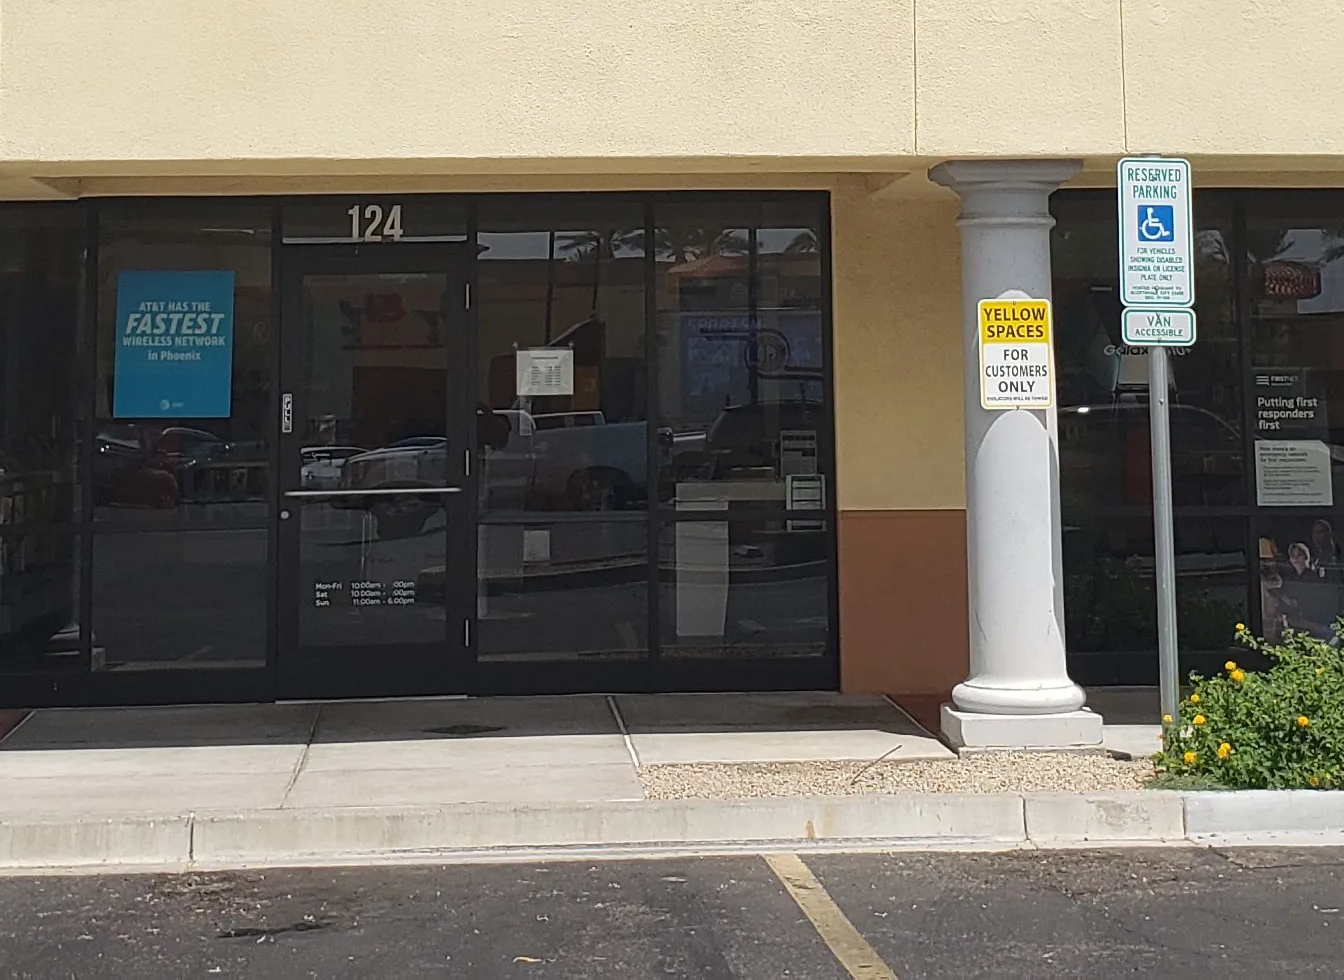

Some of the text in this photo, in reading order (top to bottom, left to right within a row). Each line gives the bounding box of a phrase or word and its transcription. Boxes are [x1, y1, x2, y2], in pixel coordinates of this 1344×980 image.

[1127, 167, 1182, 182] RESERVED
[1132, 184, 1177, 199] PARKING
[347, 204, 404, 242] 124
[1149, 247, 1176, 255] VEHICLES
[1162, 265, 1185, 273] LICENSE
[139, 301, 211, 312] AT&T HAS THE
[983, 307, 1046, 322] YELLOW
[125, 313, 225, 335] FASTEST
[1146, 316, 1171, 327] VAN
[986, 324, 1044, 338] SPACES
[1134, 328, 1184, 337] ACCESSIBLE
[122, 335, 226, 346] WIRELESS NETWORK
[147, 350, 202, 361] in Phoenix
[1003, 349, 1029, 361] FOR
[1103, 344, 1149, 356] Galax
[985, 365, 1048, 378] CUSTOMERS
[998, 381, 1036, 393] ONLY
[1257, 396, 1318, 409] Putting first
[1258, 409, 1315, 420] responders
[1258, 420, 1280, 430] first
[316, 582, 343, 590] Mon-Fri
[316, 599, 330, 607] Sun
